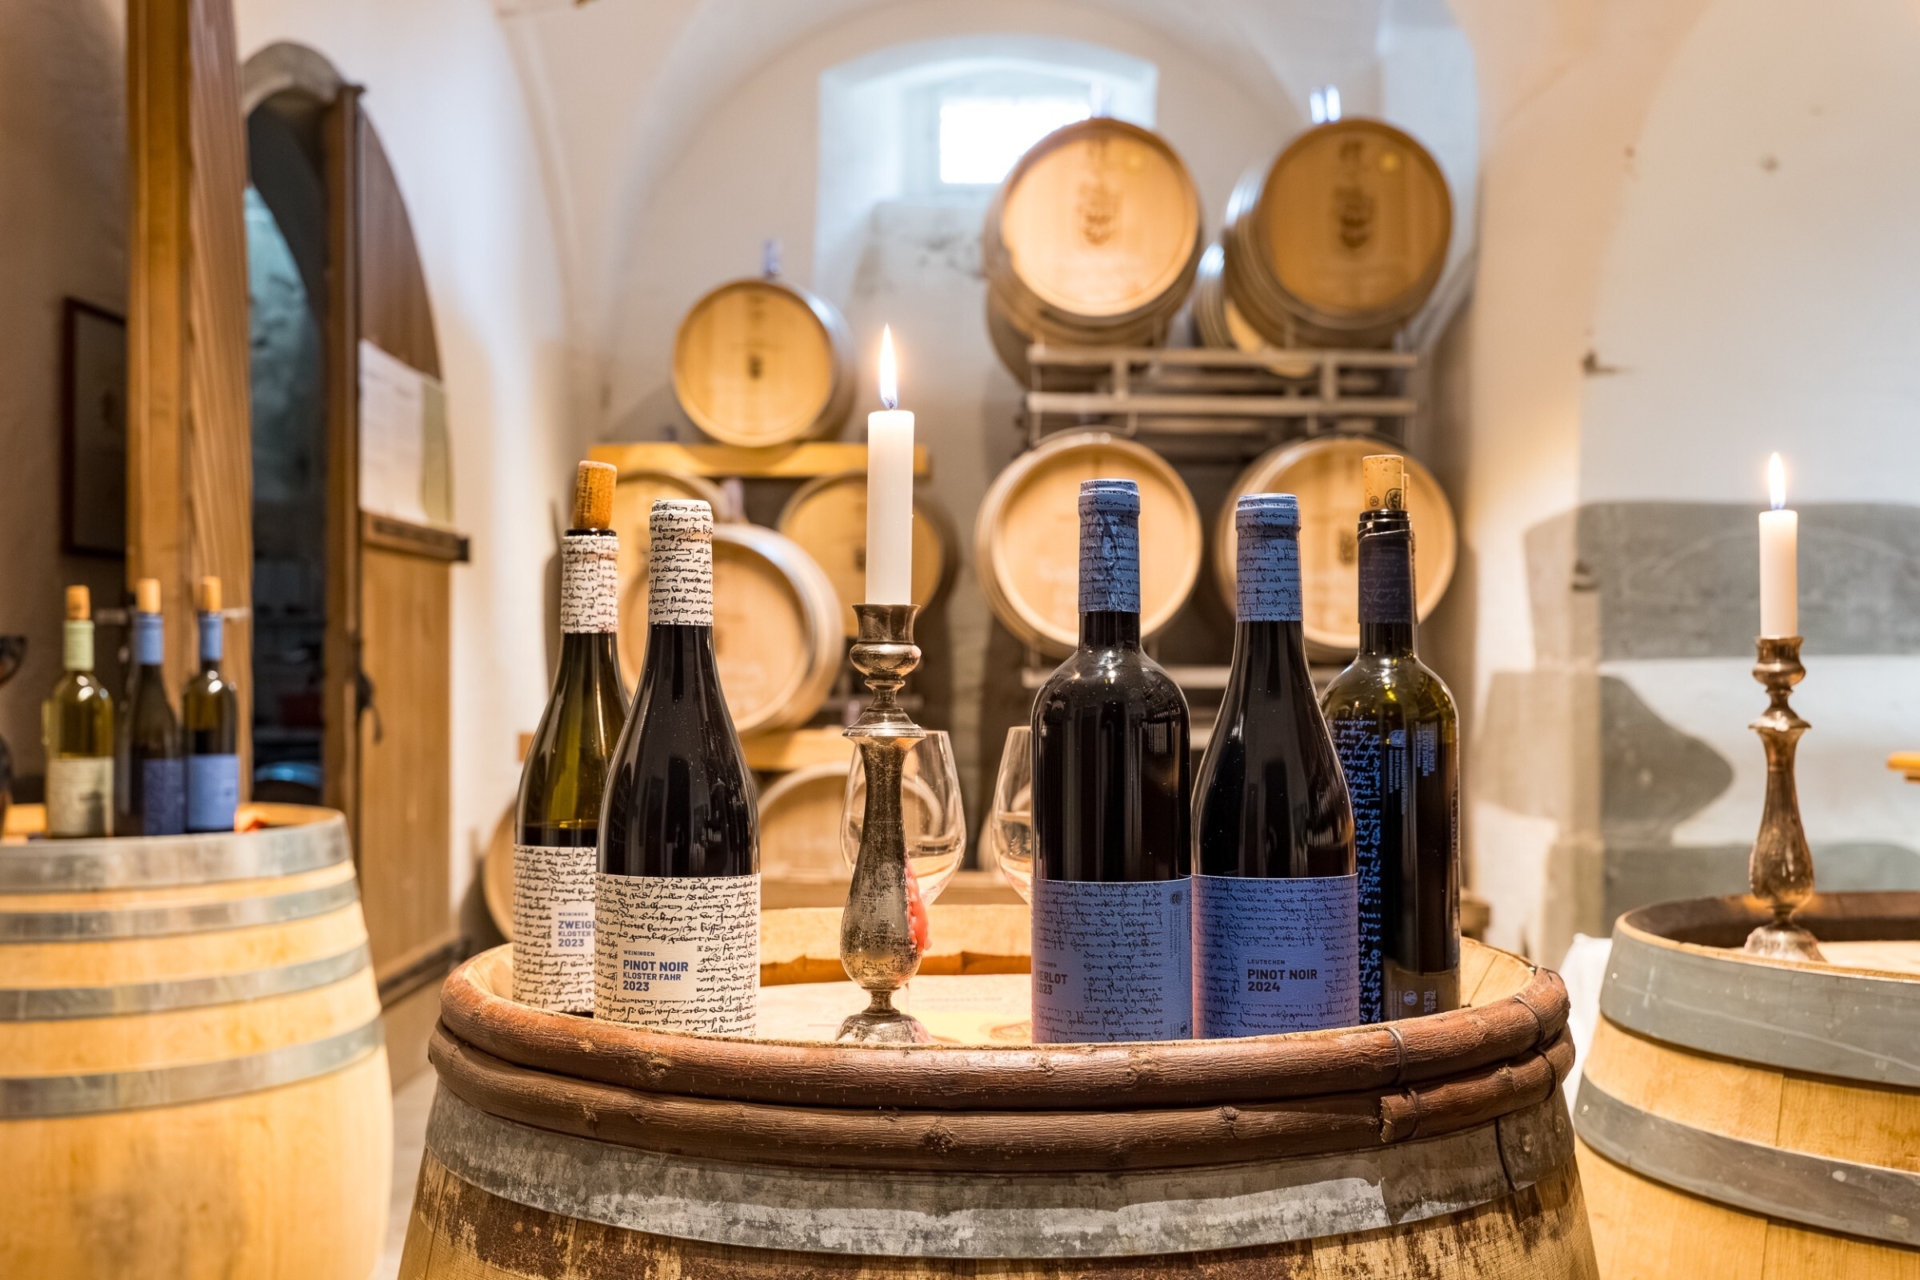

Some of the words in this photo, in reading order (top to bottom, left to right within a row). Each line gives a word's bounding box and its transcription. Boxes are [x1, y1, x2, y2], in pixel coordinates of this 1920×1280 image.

[558, 938, 585, 947] 2023
[623, 959, 656, 972] PINOT
[659, 961, 689, 972] NOIR
[622, 971, 657, 981] KLOSTER
[659, 973, 682, 981] FAHR
[1247, 969, 1286, 980] PINOT
[1289, 969, 1318, 980] NOIR
[622, 980, 650, 992] 2023
[1247, 981, 1281, 992] 2024
